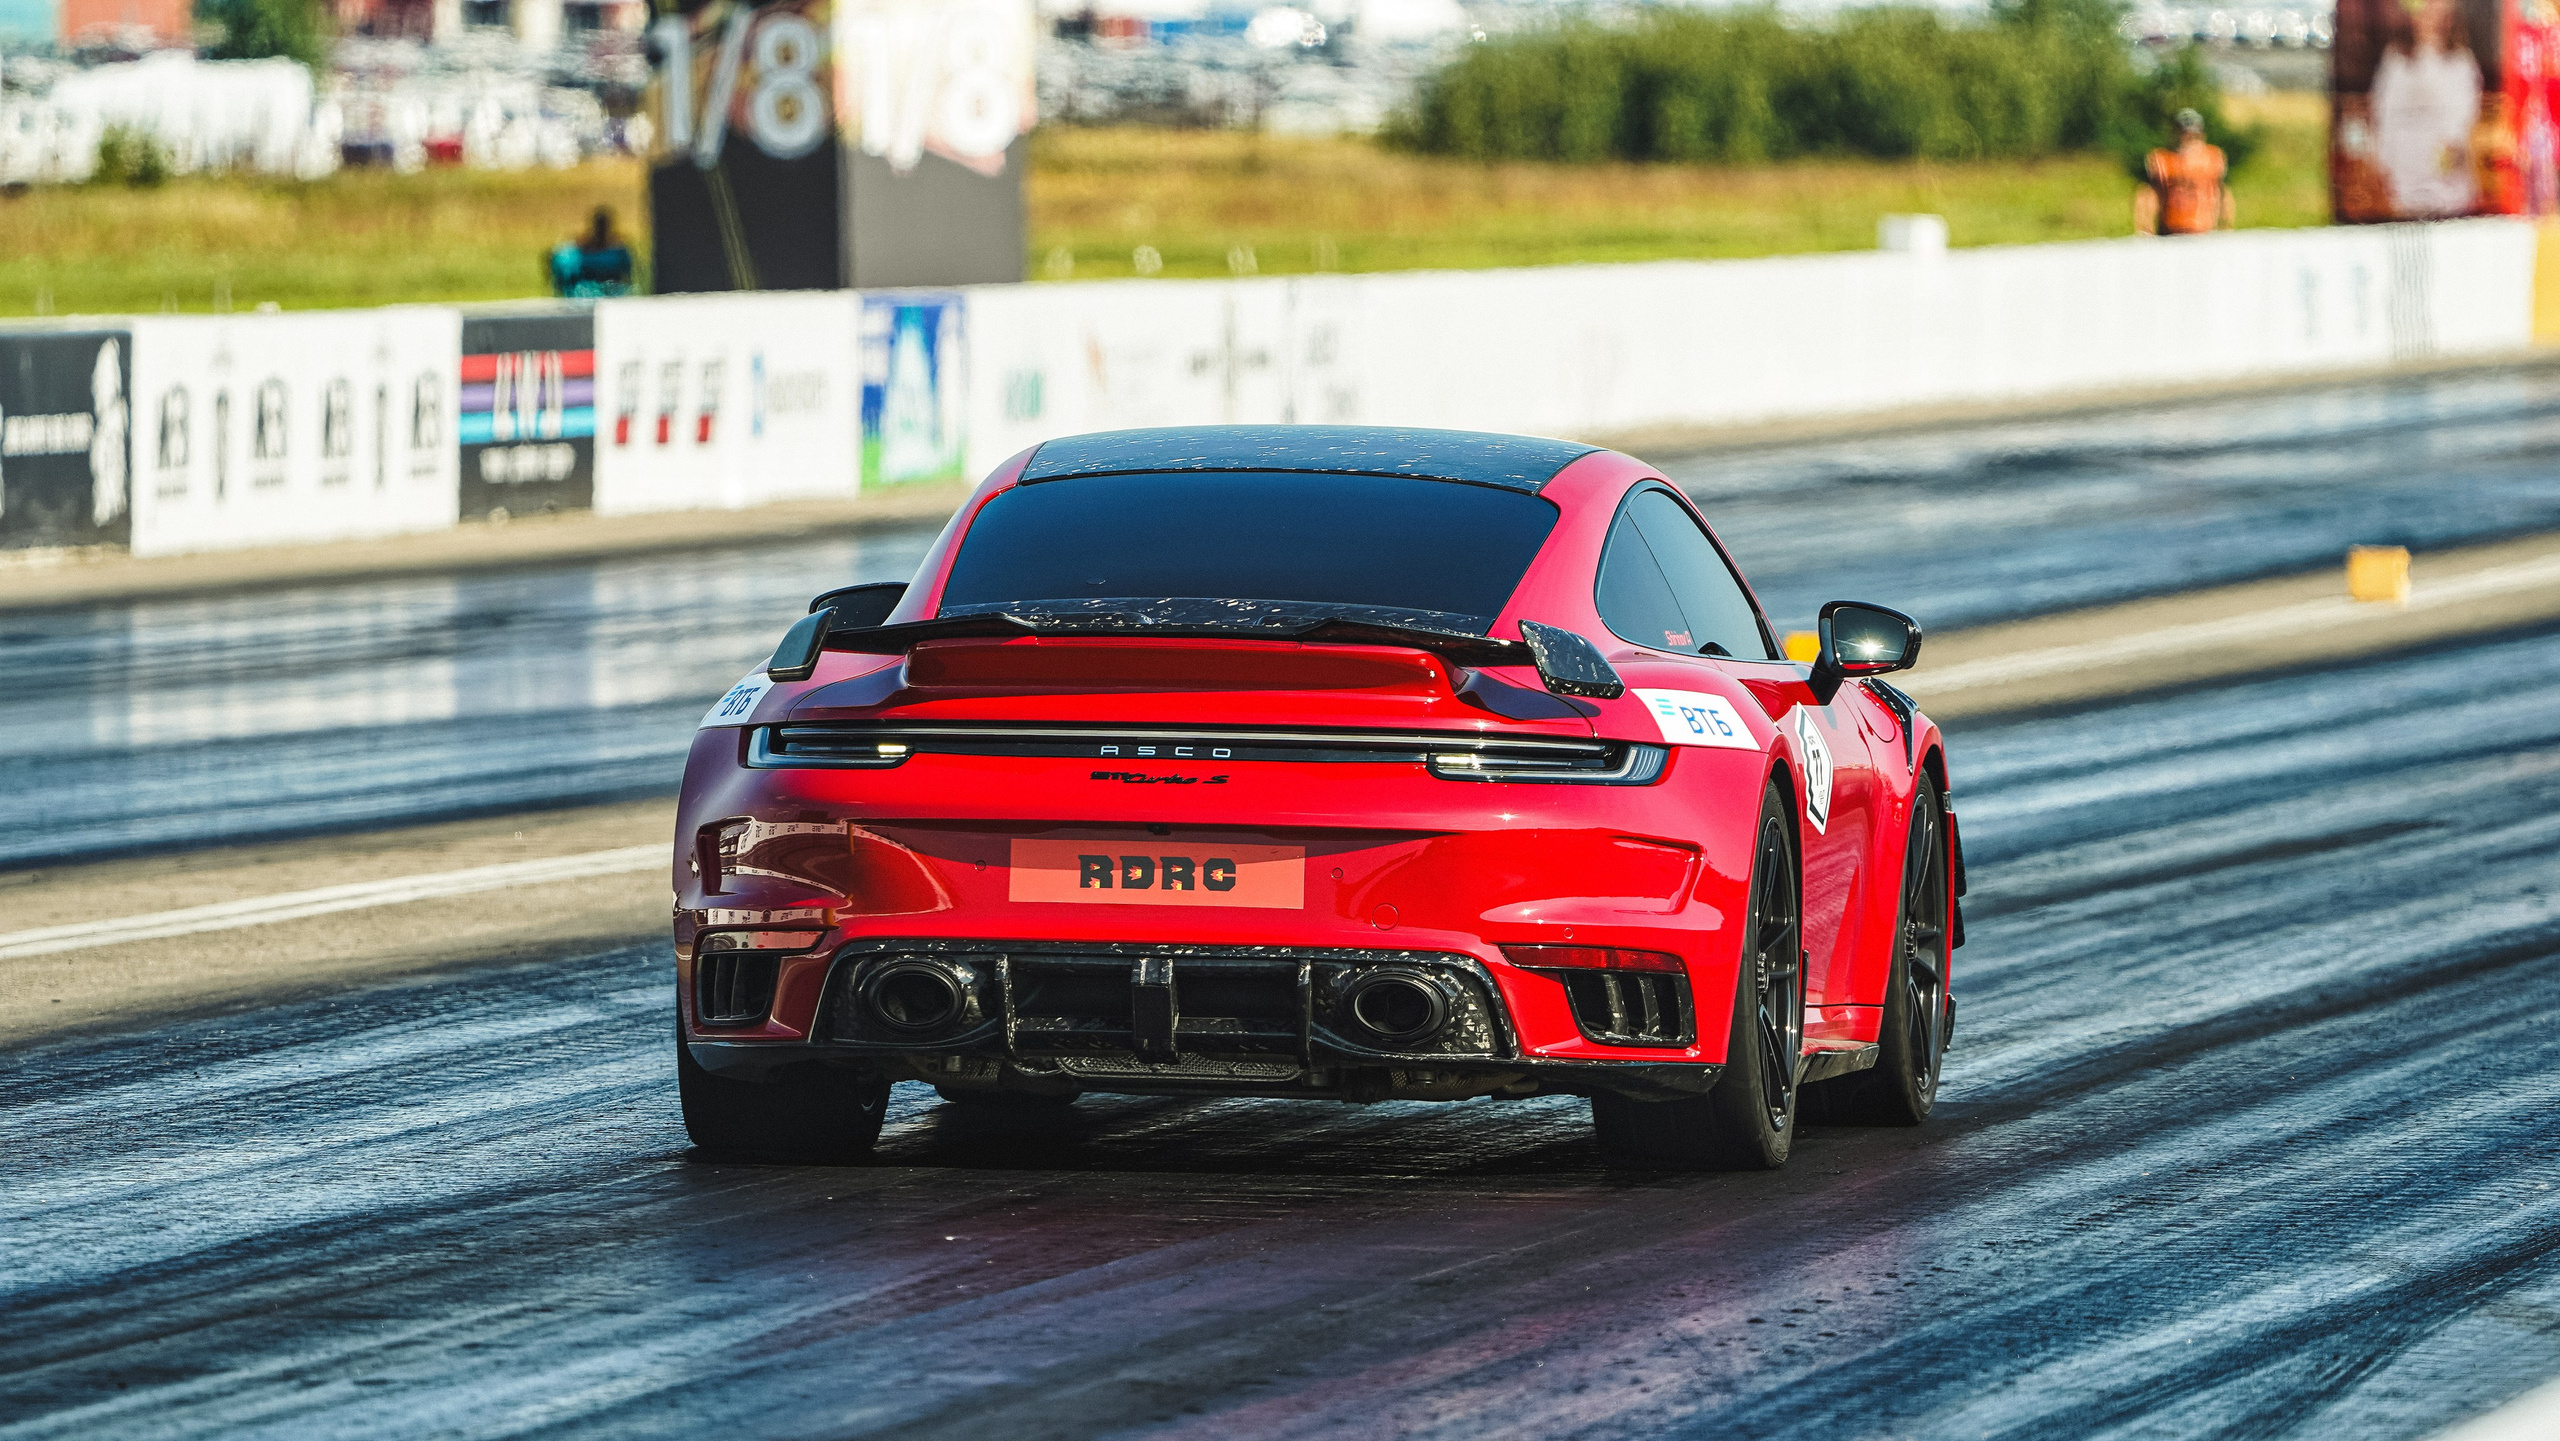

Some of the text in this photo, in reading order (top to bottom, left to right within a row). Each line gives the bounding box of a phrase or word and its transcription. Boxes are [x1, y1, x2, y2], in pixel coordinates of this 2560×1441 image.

[646, 8, 824, 169] 1/8
[845, 8, 1024, 168] 1/8
[720, 686, 761, 717] ВТБ
[1679, 706, 1733, 736] ВТБ
[1100, 745, 1231, 758] ASCO
[1202, 775, 1229, 784] S
[1078, 854, 1236, 891] RDRC
